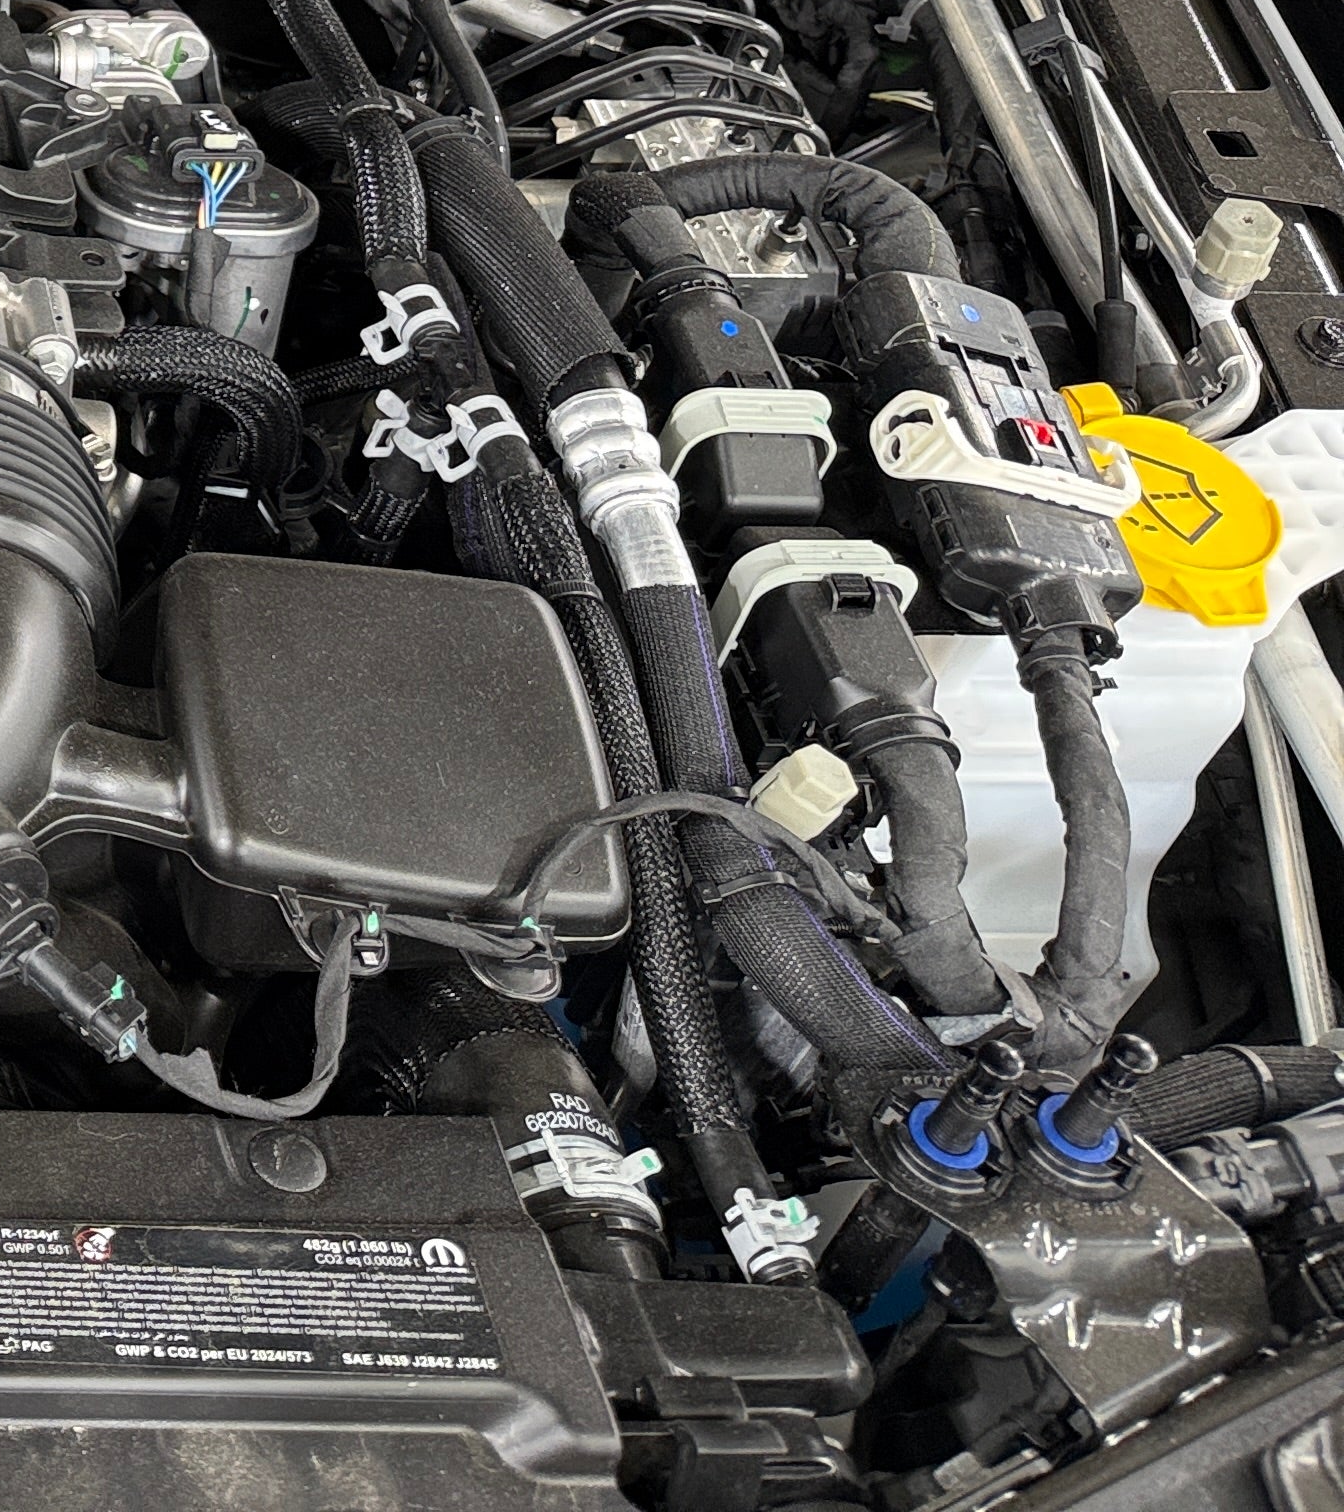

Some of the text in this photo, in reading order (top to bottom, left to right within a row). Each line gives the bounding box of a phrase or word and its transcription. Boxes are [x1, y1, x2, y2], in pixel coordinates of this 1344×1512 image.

[548, 1092, 591, 1114] RAD
[524, 1110, 619, 1146] 68280782AD
[1, 1228, 60, 1241] R-1234yf
[2, 1244, 69, 1255] GWP 0.501
[302, 1238, 340, 1254] 482g
[390, 1241, 412, 1257] lb)
[314, 1254, 343, 1265] CO2
[345, 1257, 361, 1268] eq
[21, 1340, 53, 1352] PAG
[115, 1345, 312, 1364] GWP & CO2 per EU 2024/573
[342, 1354, 373, 1366] SAE
